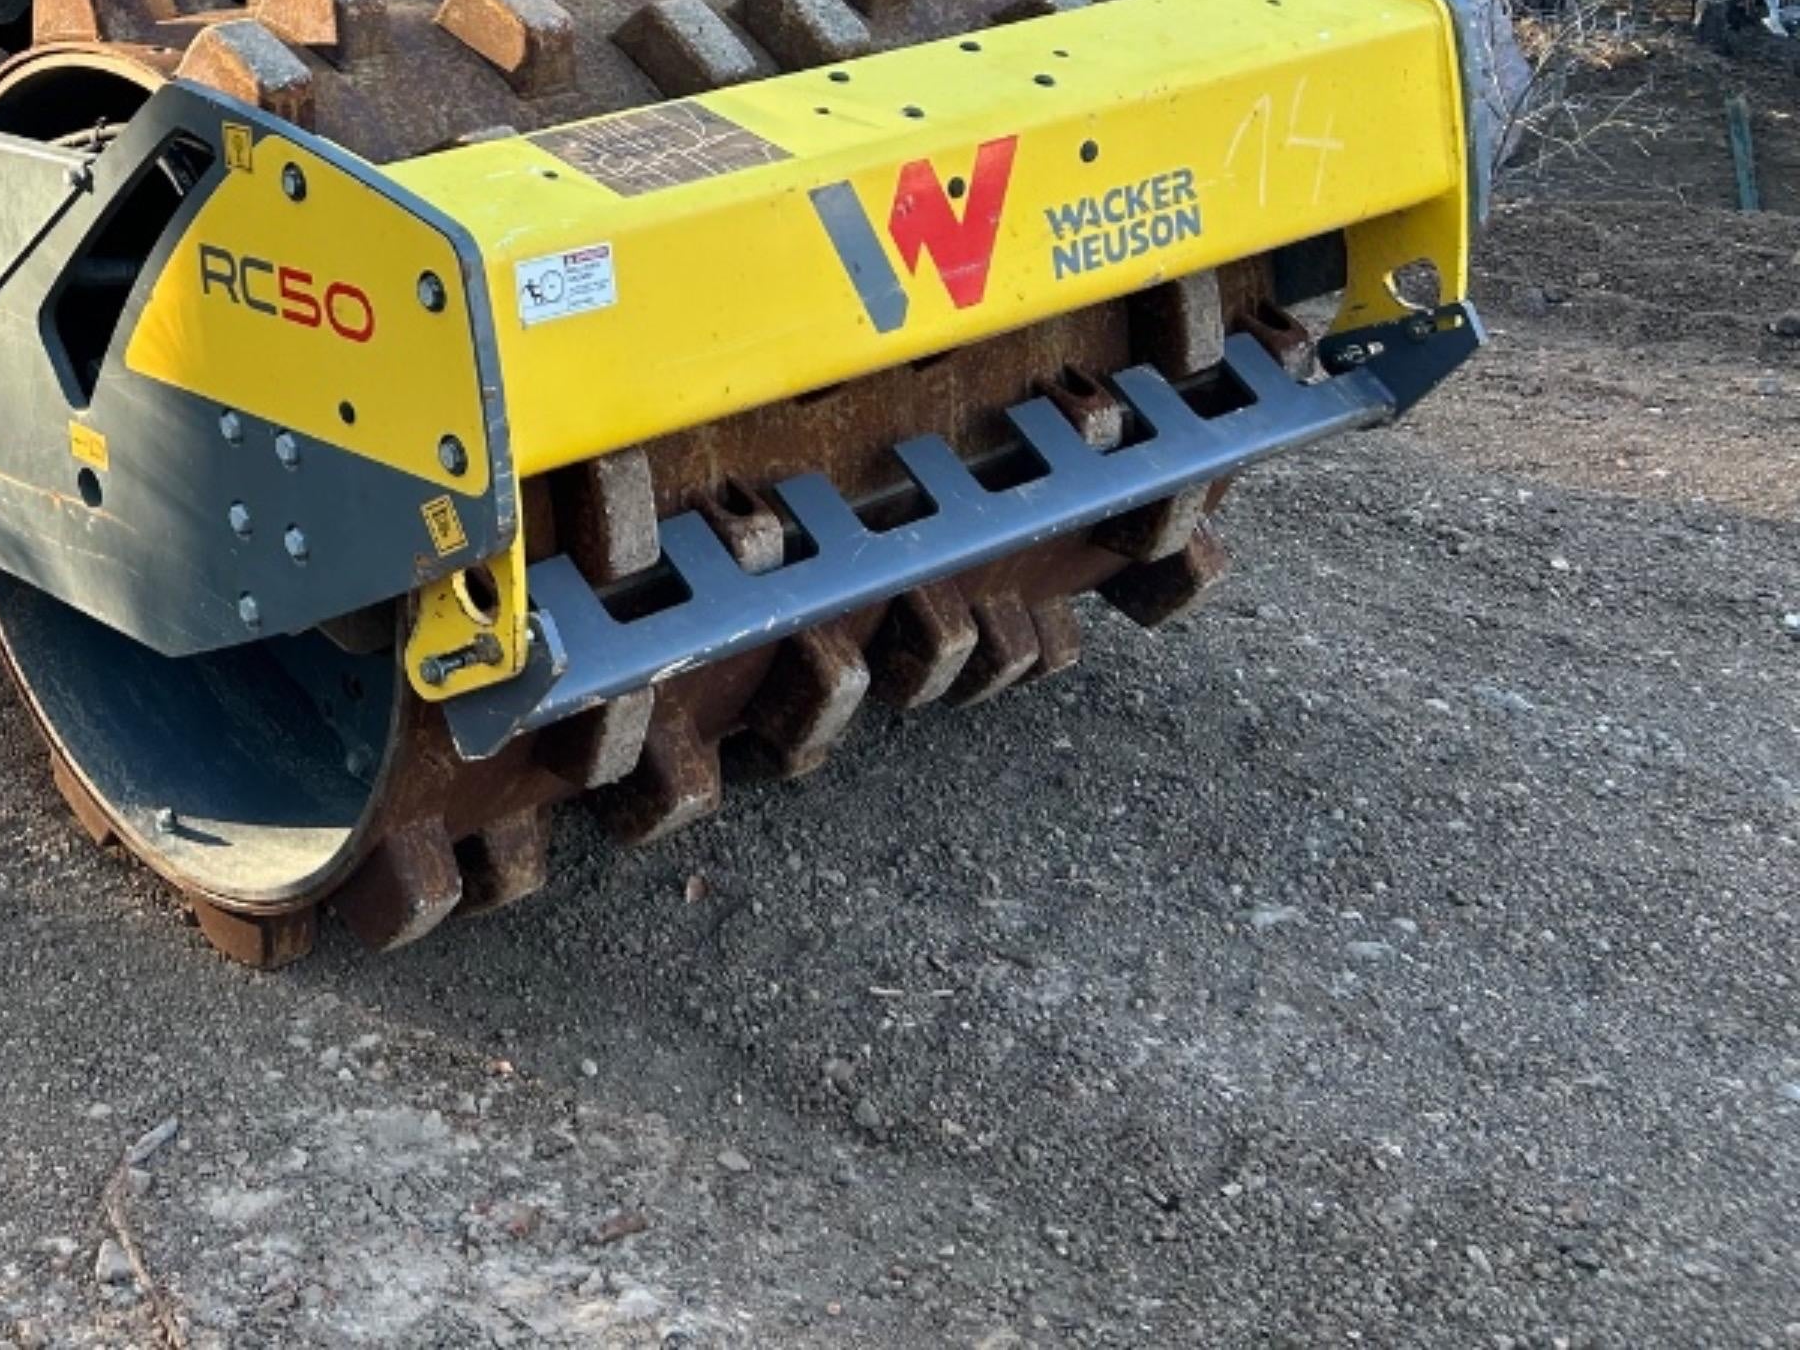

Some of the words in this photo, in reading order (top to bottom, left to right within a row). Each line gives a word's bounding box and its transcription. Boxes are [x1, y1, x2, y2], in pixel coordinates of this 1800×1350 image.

[1044, 167, 1198, 240] WACKER
[1051, 203, 1202, 281] NEUSON
[198, 242, 375, 343] RC50
